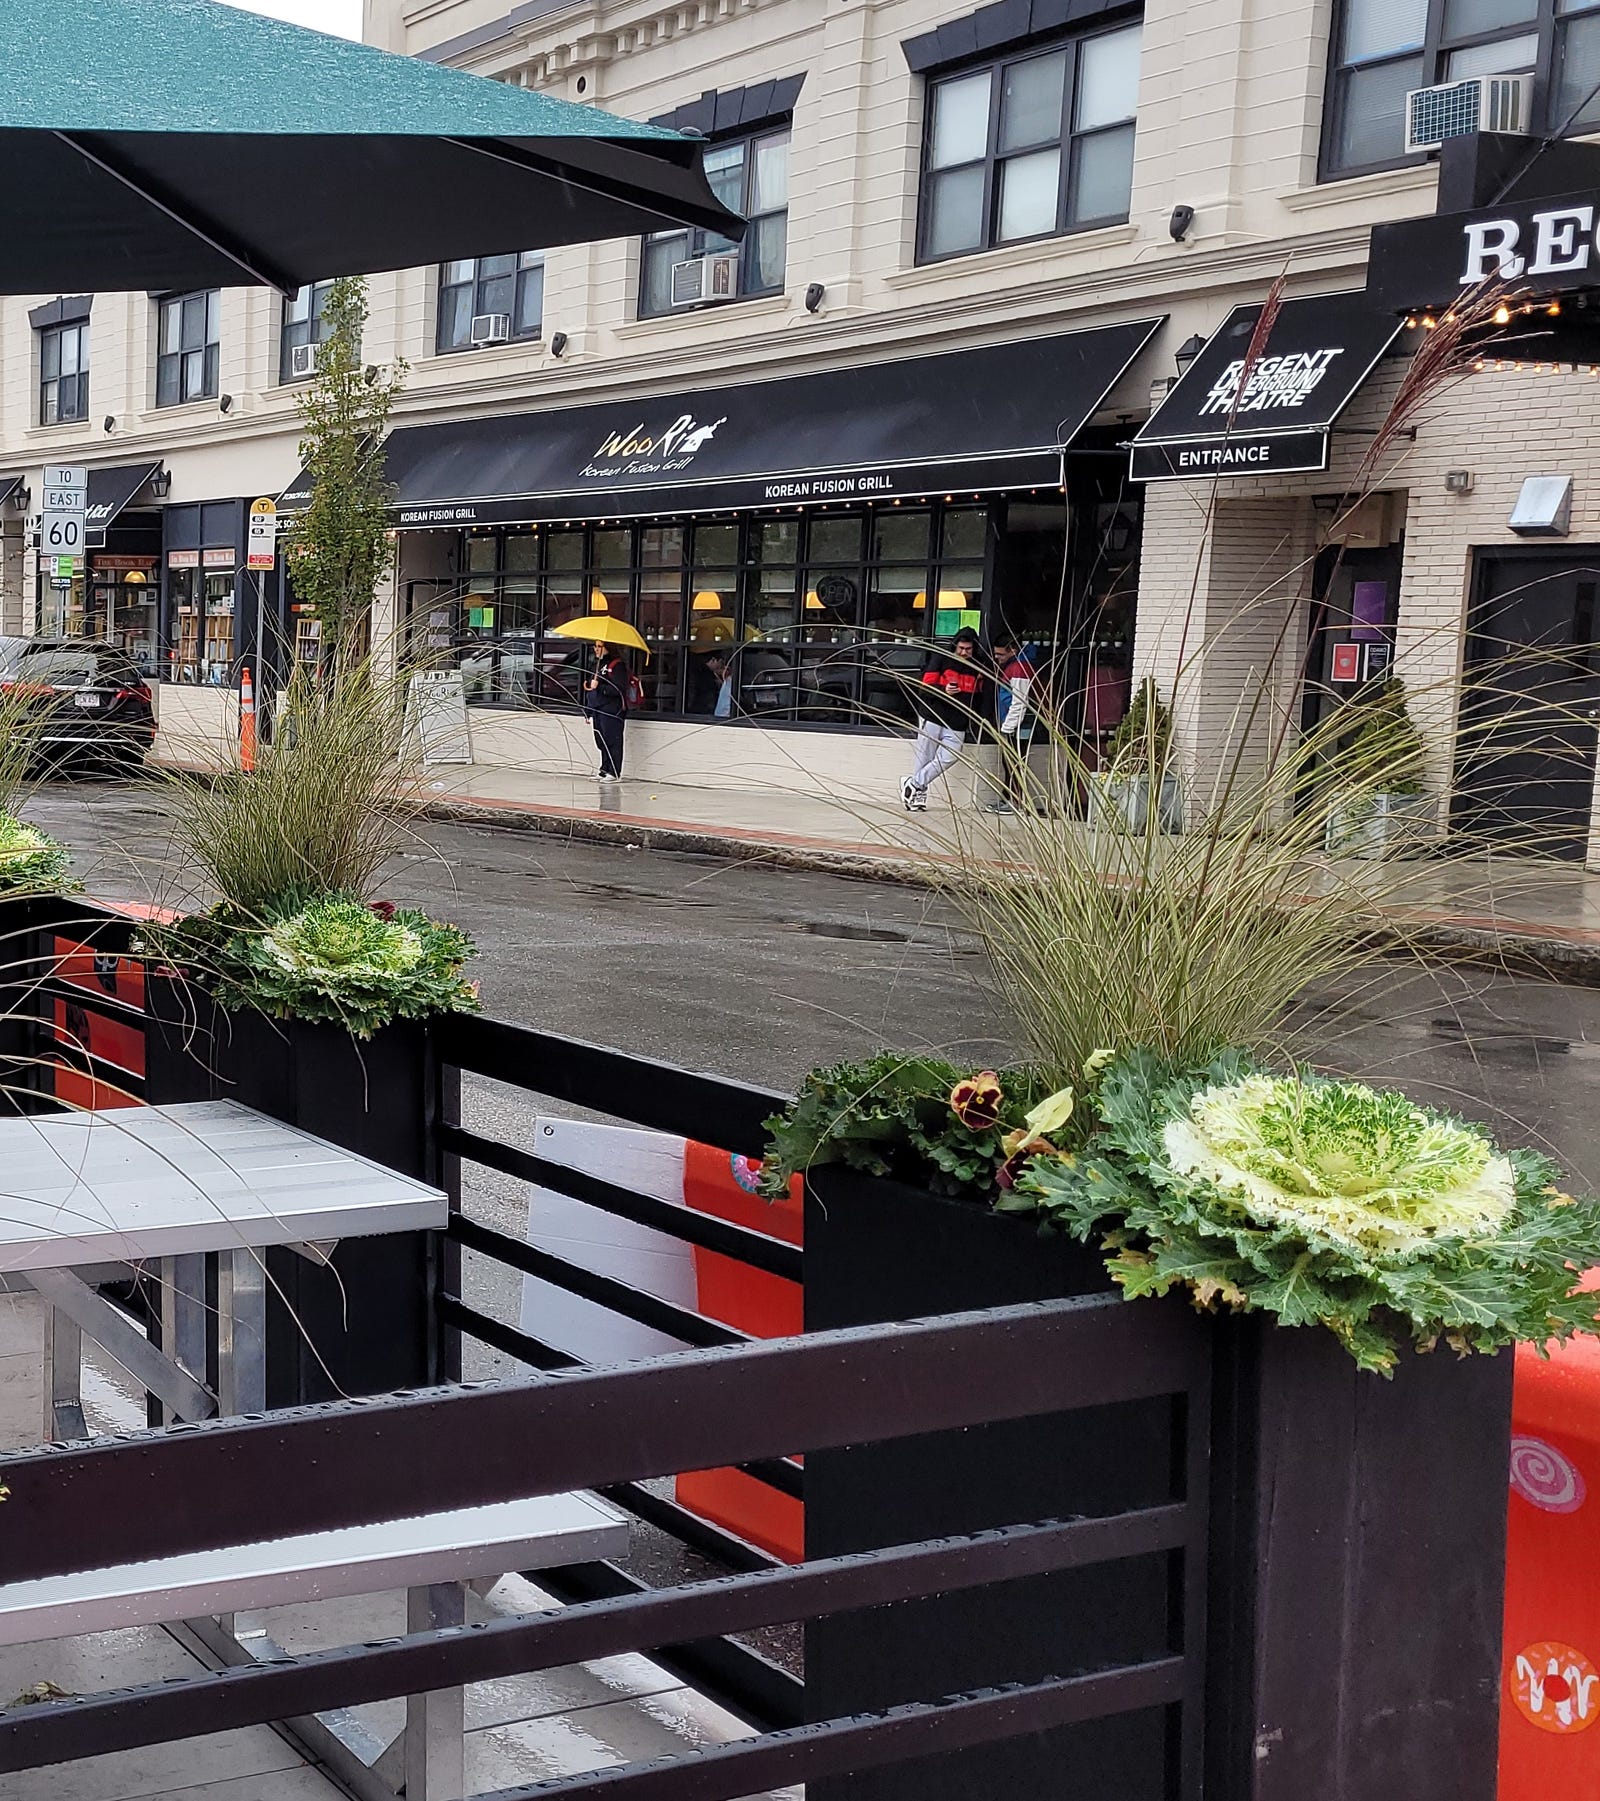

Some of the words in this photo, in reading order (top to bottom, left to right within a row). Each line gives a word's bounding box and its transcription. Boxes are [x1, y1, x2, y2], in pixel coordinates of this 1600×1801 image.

[1459, 206, 1600, 285] RE
[1198, 389, 1313, 416] THEATRE
[578, 463, 621, 477] Korean
[622, 460, 661, 474] Fusion
[662, 456, 694, 470] Grill
[1179, 445, 1270, 467] ENTRANCE
[59, 471, 72, 483] TO
[765, 482, 810, 498] KOREAN
[812, 478, 855, 494] FUSION
[858, 475, 893, 490] GRILL
[50, 492, 80, 506] EAST
[400, 511, 428, 522] KOREAN
[429, 509, 454, 521] FUSION
[455, 507, 477, 519] GRILL
[49, 521, 78, 545] 60
